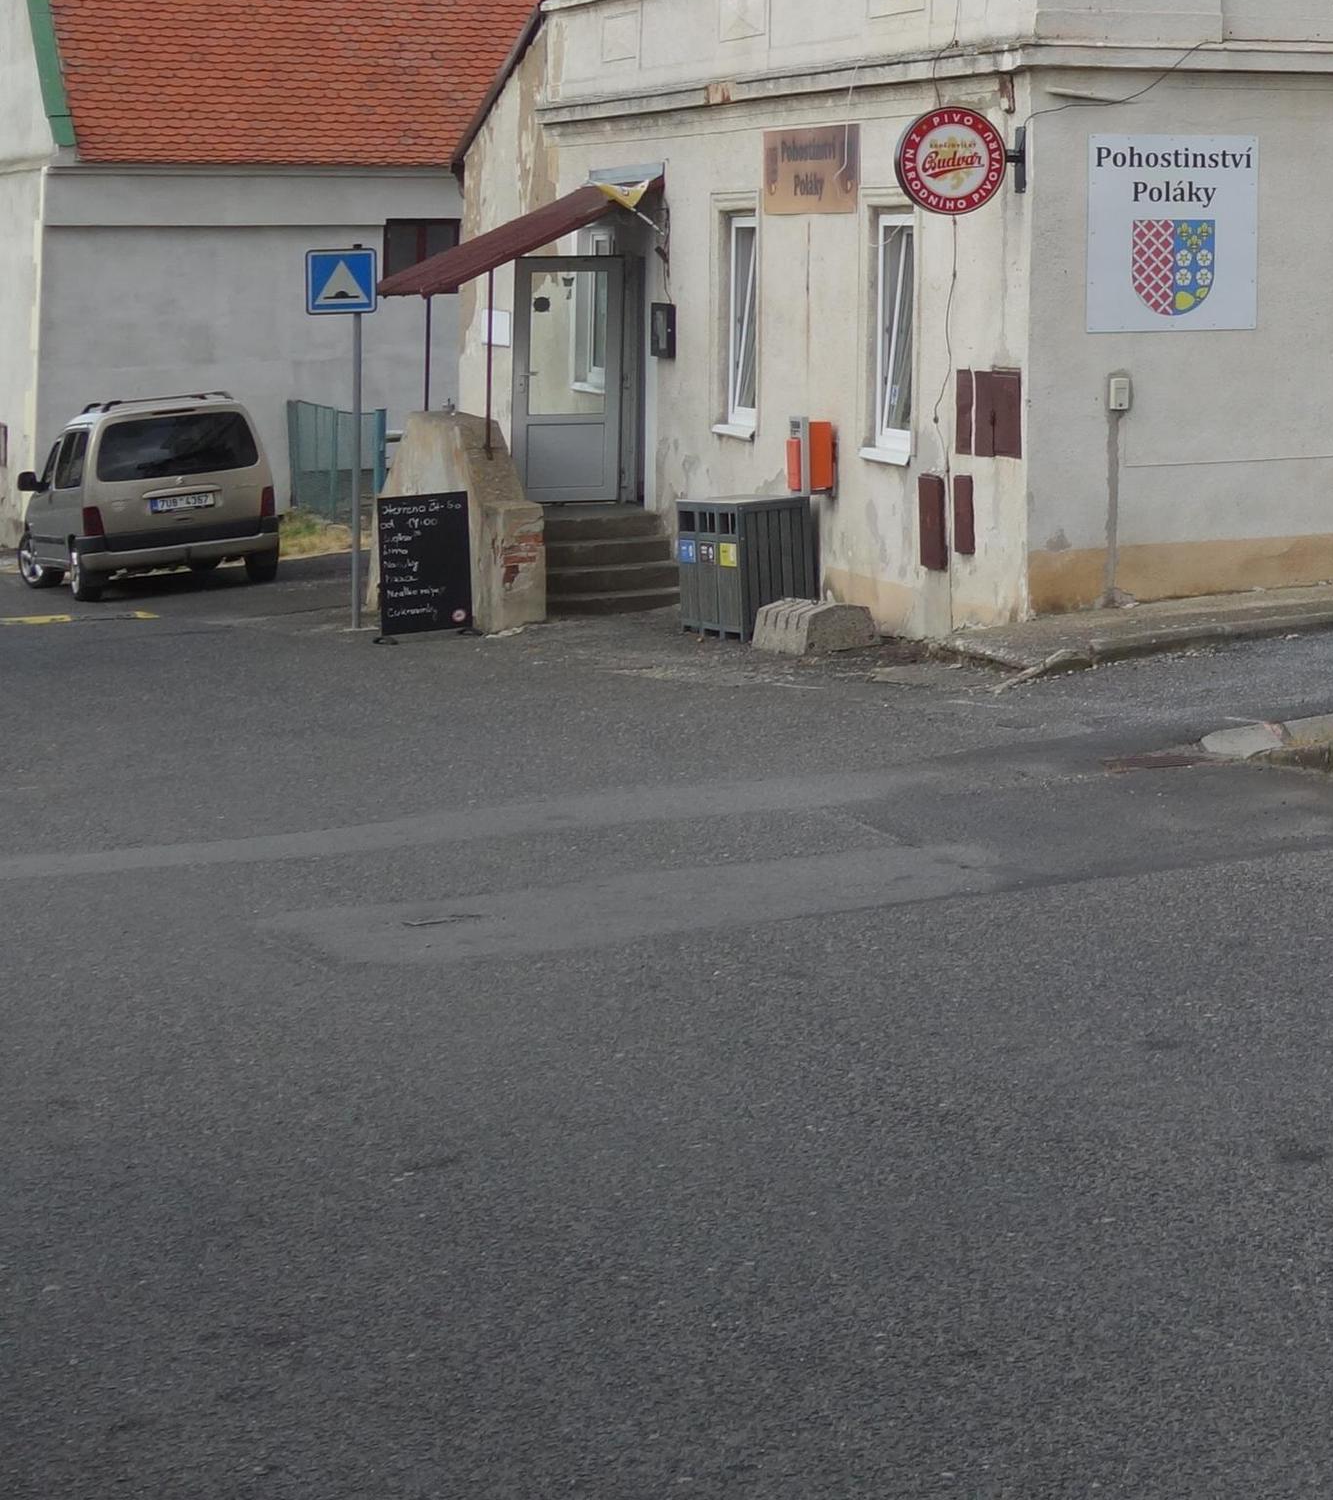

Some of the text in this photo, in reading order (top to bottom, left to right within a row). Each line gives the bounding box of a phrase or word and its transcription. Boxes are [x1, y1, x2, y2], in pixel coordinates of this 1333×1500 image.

[932, 113, 973, 126] PIVO
[1096, 146, 1252, 168] Pohostinství
[904, 132, 1001, 209] Z NÁRODNÍHO PIVOVARU
[1133, 180, 1216, 208] Poláky
